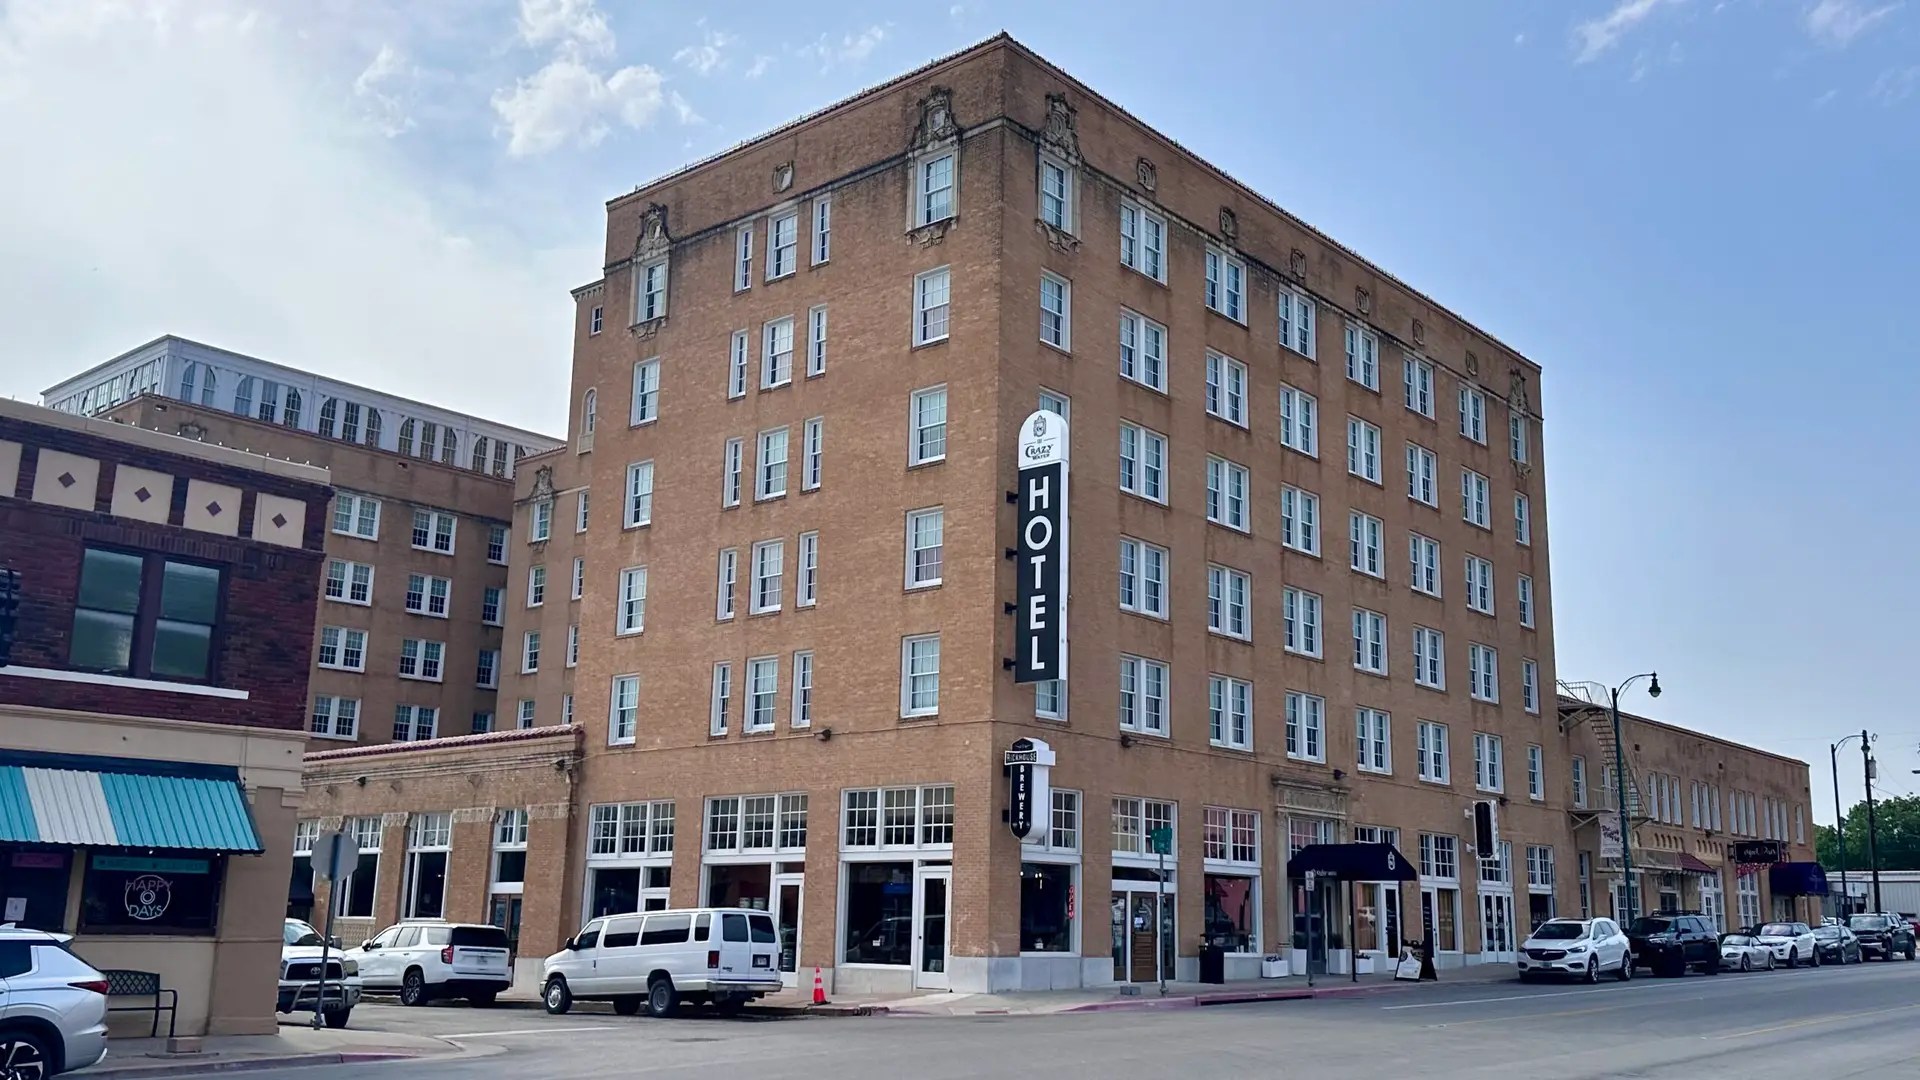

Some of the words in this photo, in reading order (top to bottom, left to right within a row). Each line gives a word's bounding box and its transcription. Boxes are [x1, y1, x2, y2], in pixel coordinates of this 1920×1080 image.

[1025, 444, 1054, 458] CRAZY
[1024, 475, 1053, 671] HOTEL
[1018, 764, 1026, 830] BREWERY
[125, 880, 173, 892] HAPPY
[128, 904, 163, 917] DAYS
